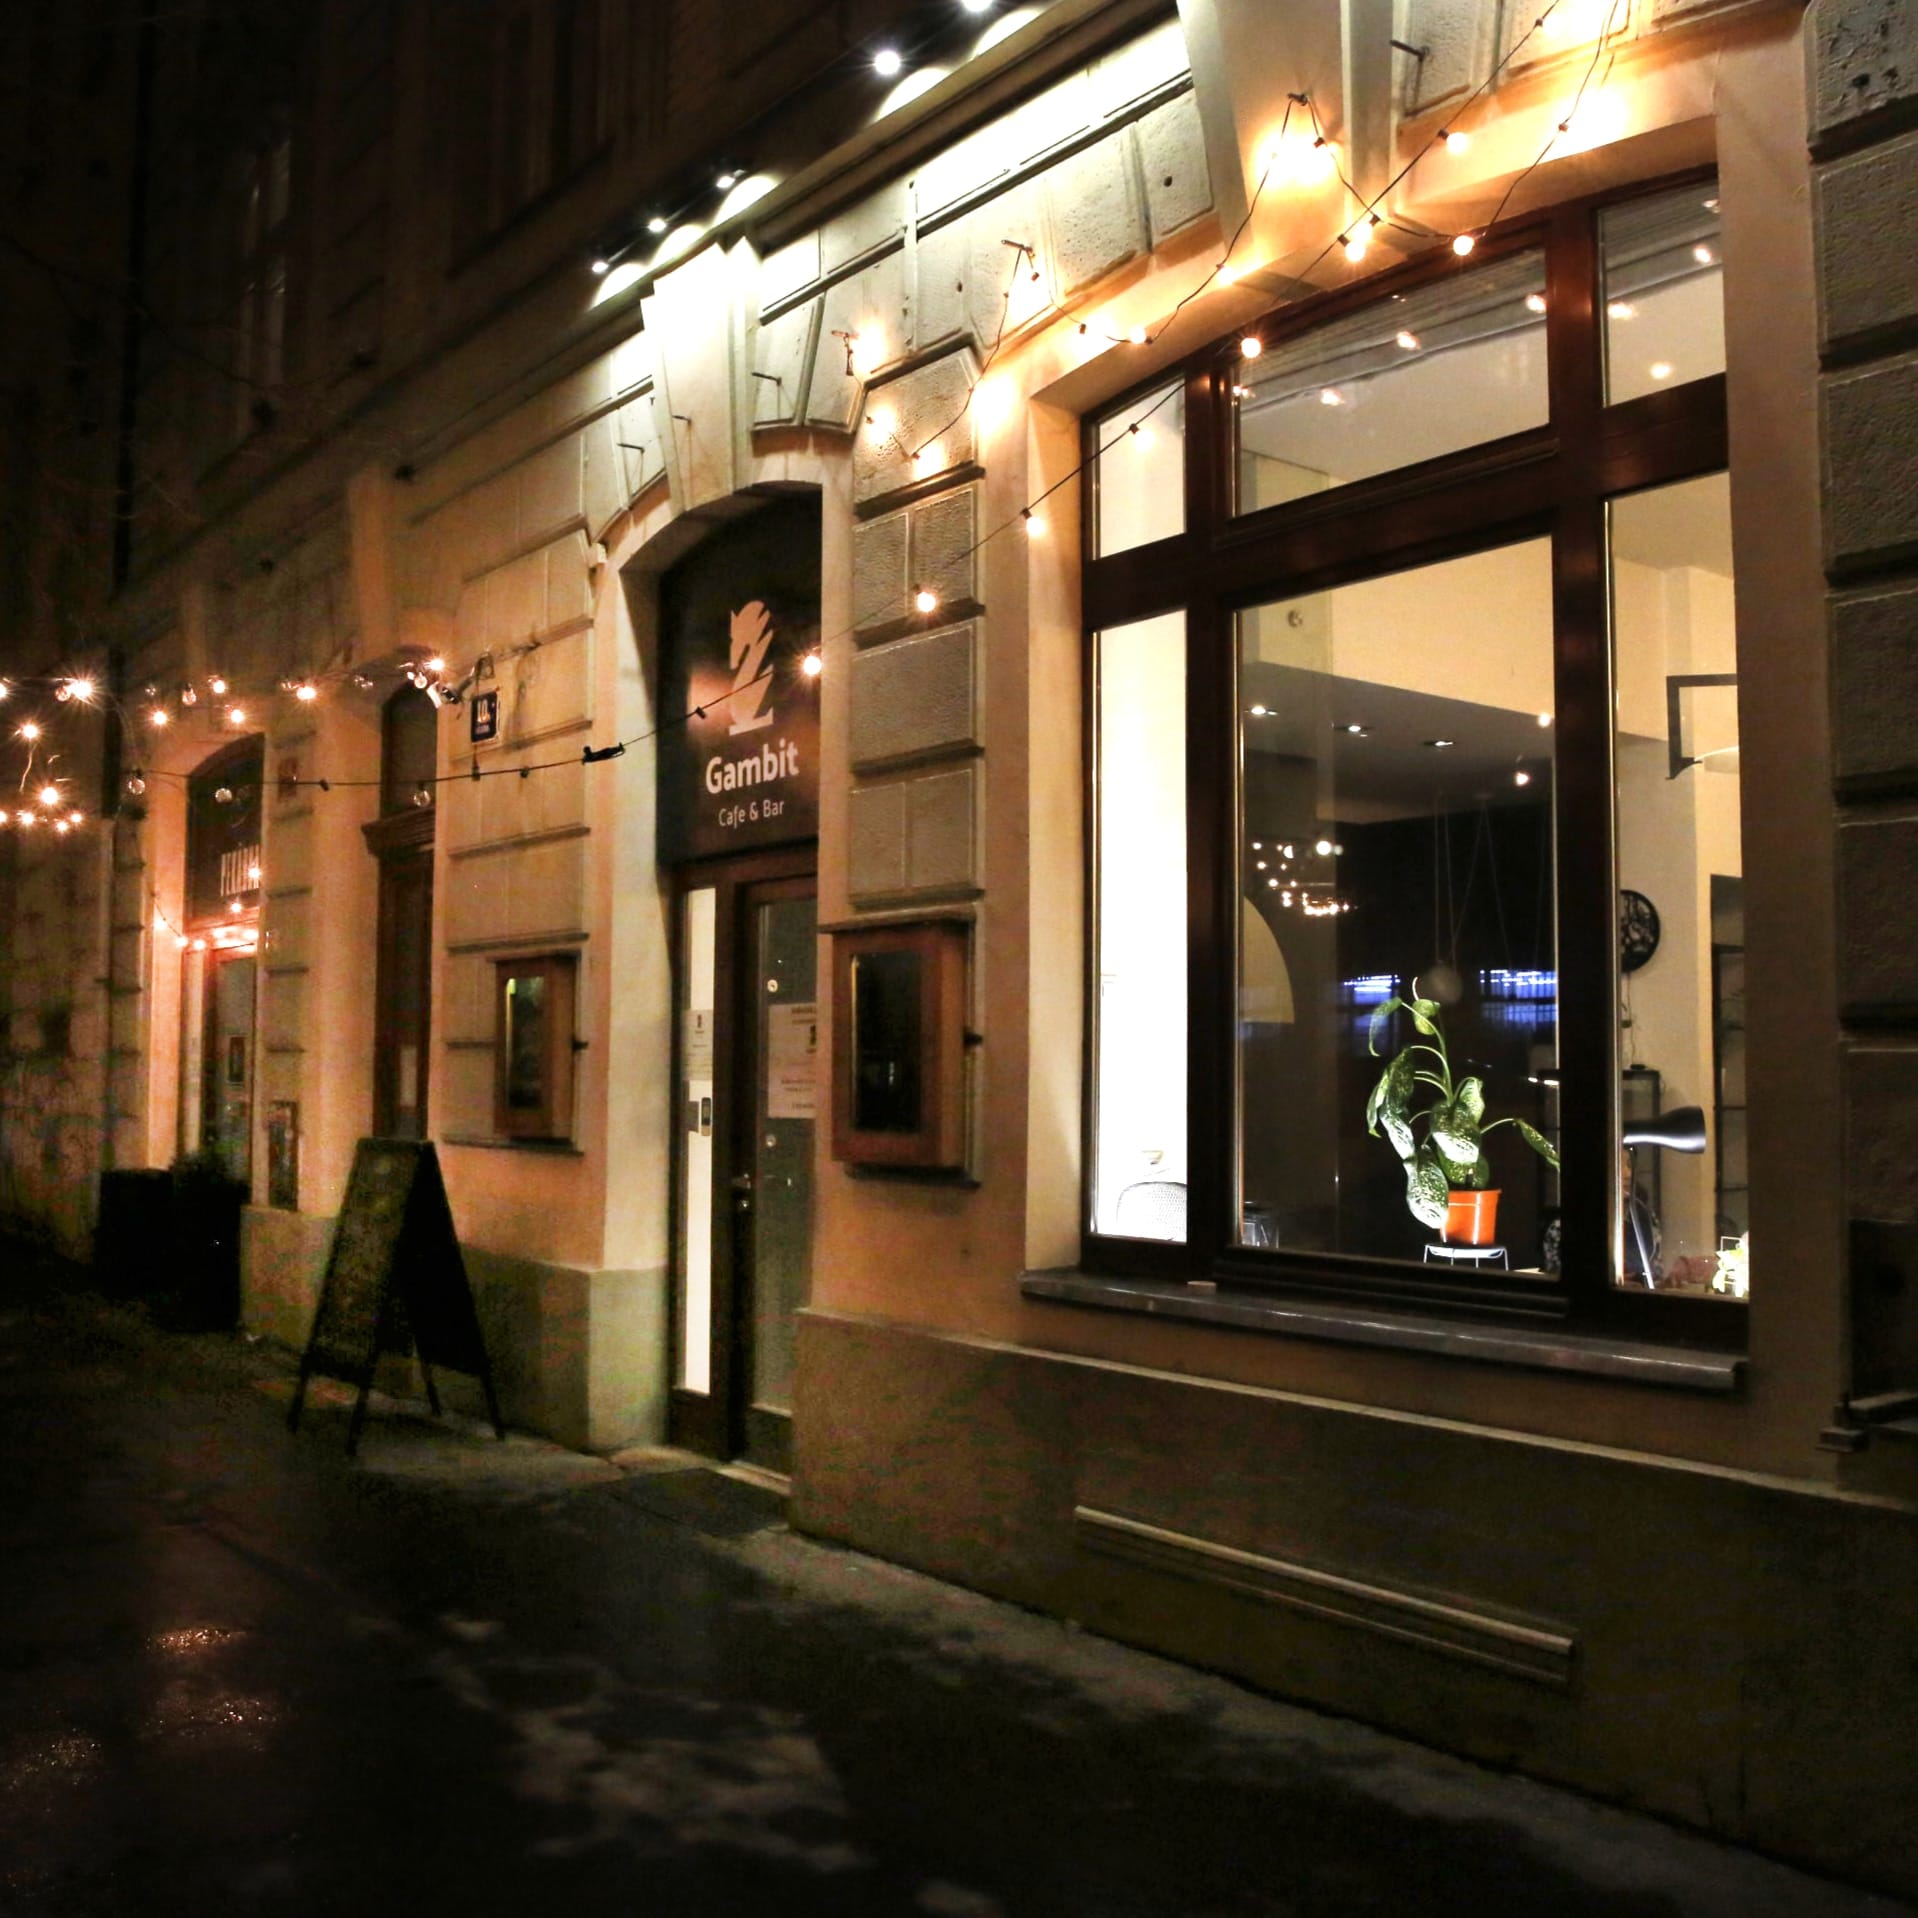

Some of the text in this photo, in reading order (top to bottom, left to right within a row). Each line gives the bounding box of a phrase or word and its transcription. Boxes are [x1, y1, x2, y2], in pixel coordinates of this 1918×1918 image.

[705, 737, 800, 794] Gambit
[718, 799, 785, 830] Cafe & Bar
